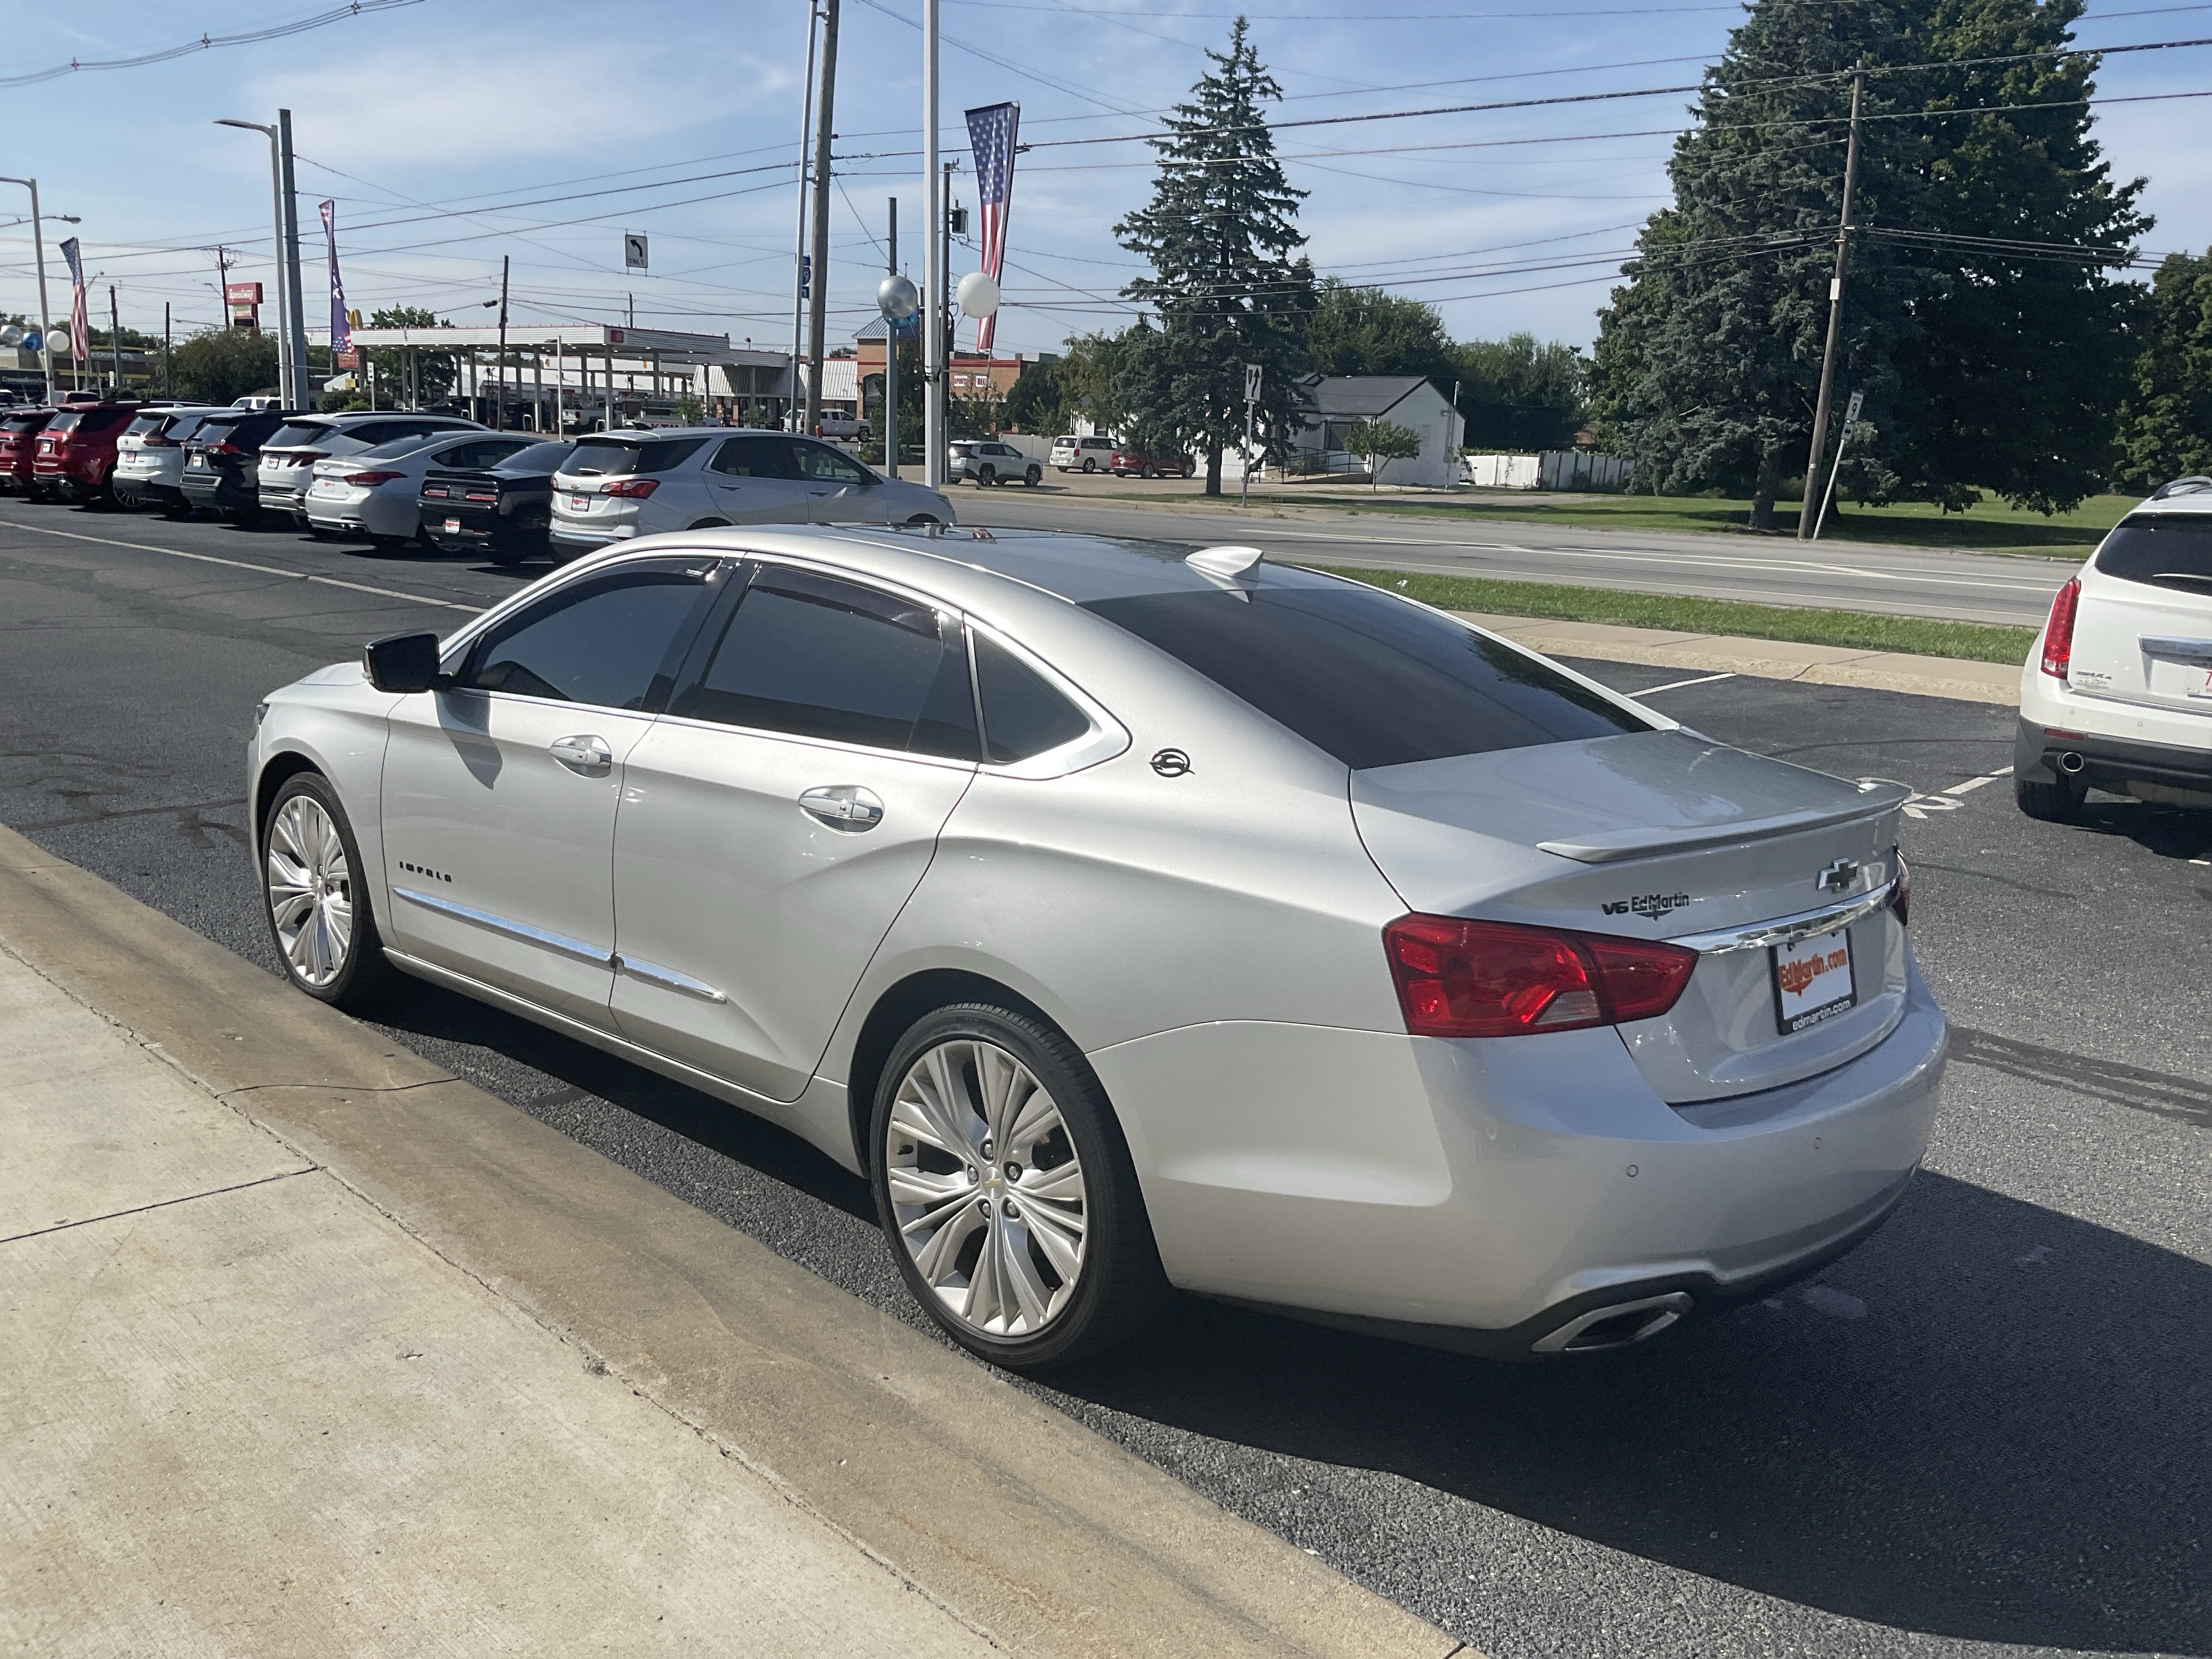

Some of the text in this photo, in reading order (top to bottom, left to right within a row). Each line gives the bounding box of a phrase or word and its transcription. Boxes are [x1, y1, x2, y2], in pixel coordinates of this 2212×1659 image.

[1851, 403, 1858, 417] 9
[399, 861, 452, 883] IMPALA
[1601, 891, 1689, 915] V6 EdMartin
[1778, 948, 1848, 989] EdMartin.com
[1792, 1000, 1850, 1031] edmartin.com
